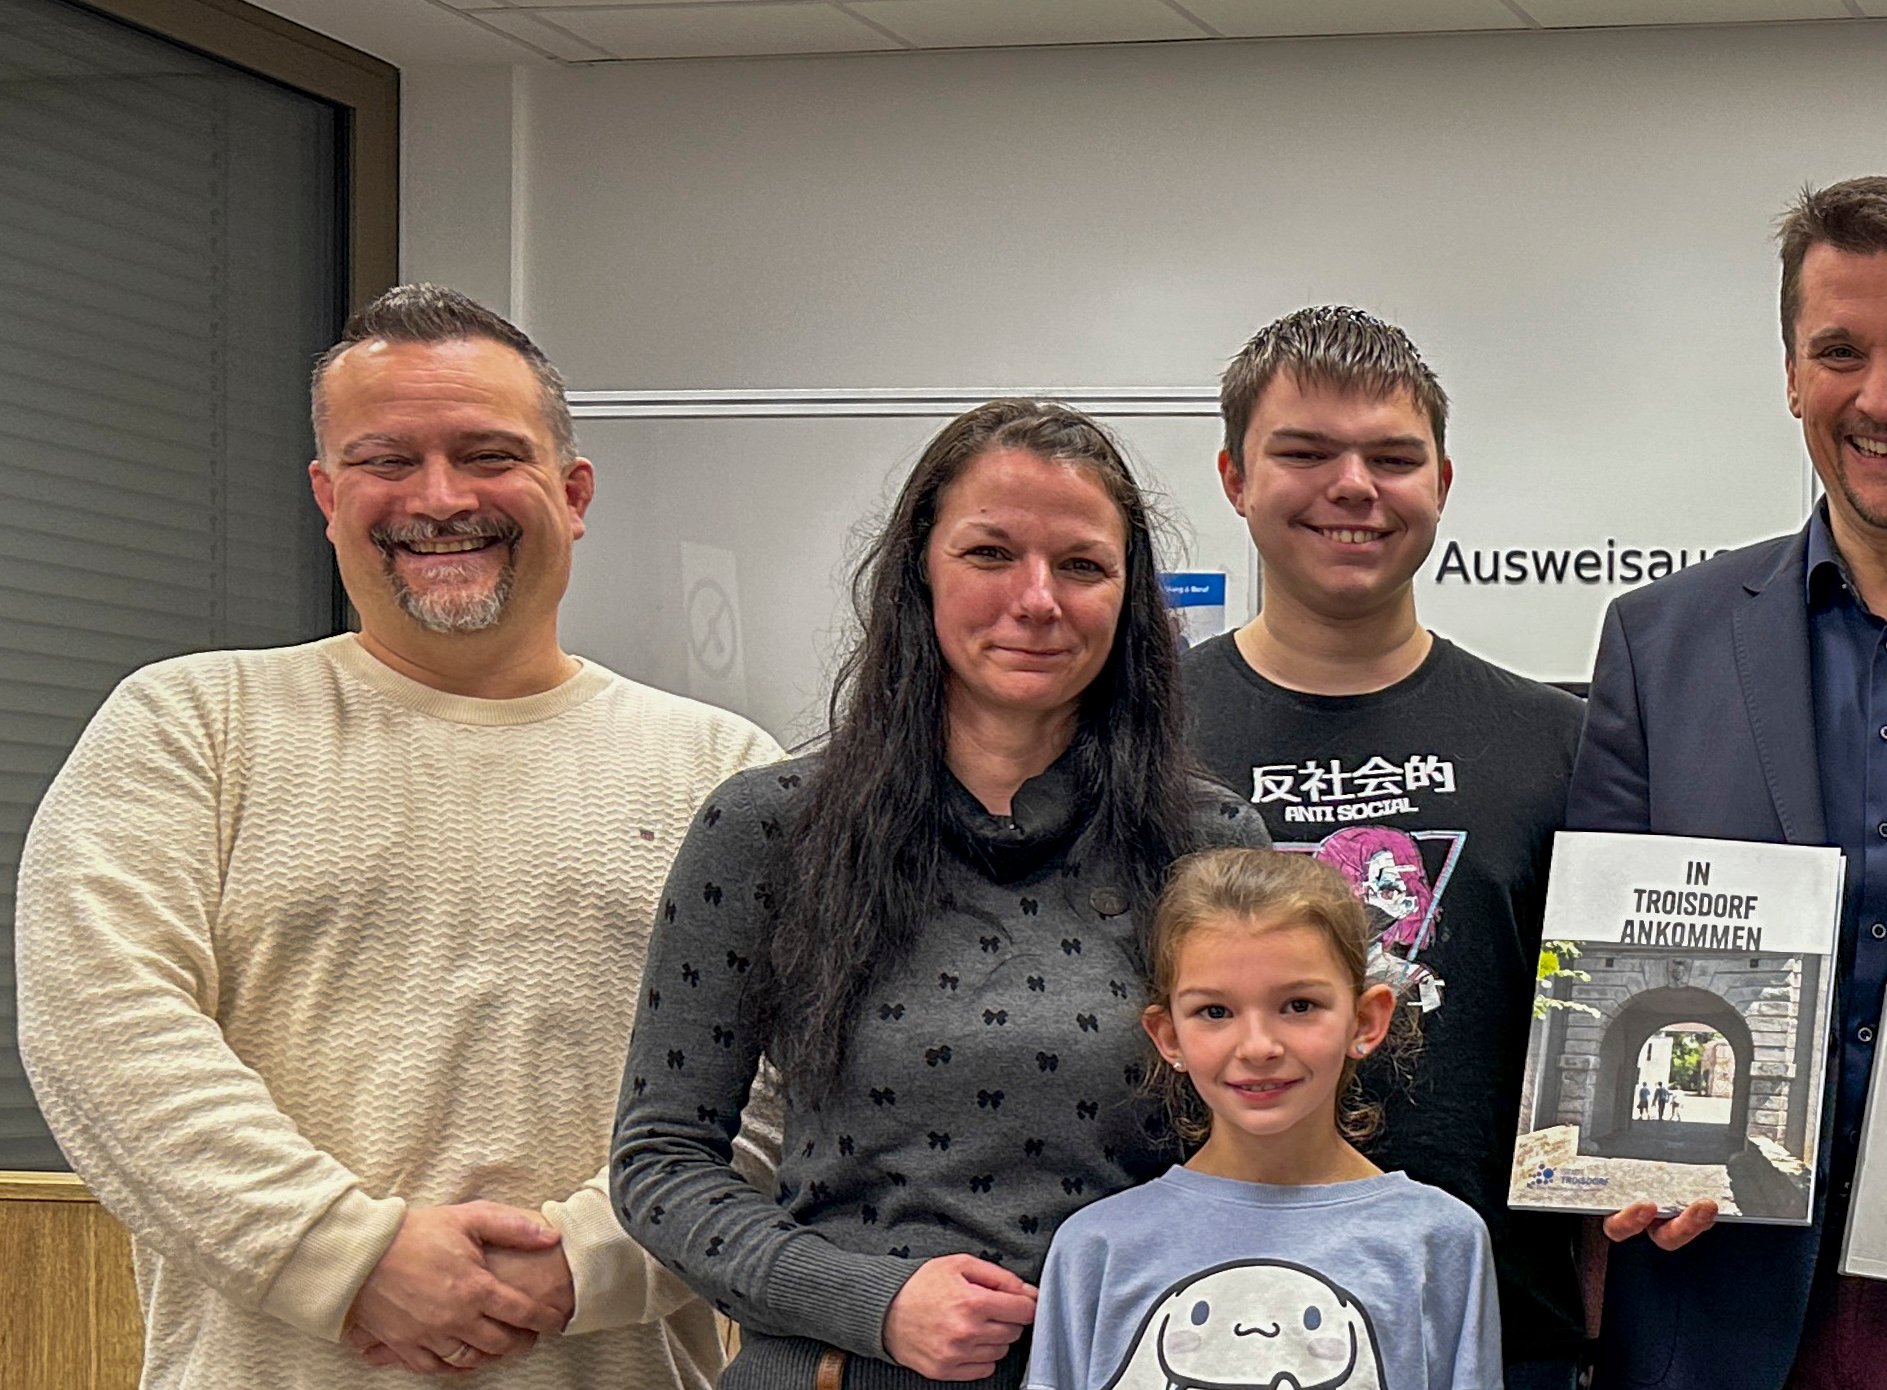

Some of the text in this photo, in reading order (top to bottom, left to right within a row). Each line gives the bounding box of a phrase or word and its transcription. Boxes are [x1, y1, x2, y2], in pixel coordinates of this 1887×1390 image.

[1434, 538, 1728, 585] Ausweisa
[1250, 754, 1457, 803] 反社会的
[1284, 798, 1420, 823] ANTI SOCIAL
[1686, 860, 1711, 886] IN
[1633, 888, 1759, 920] TROISDORF
[1620, 919, 1763, 951] ANKOMMEN
